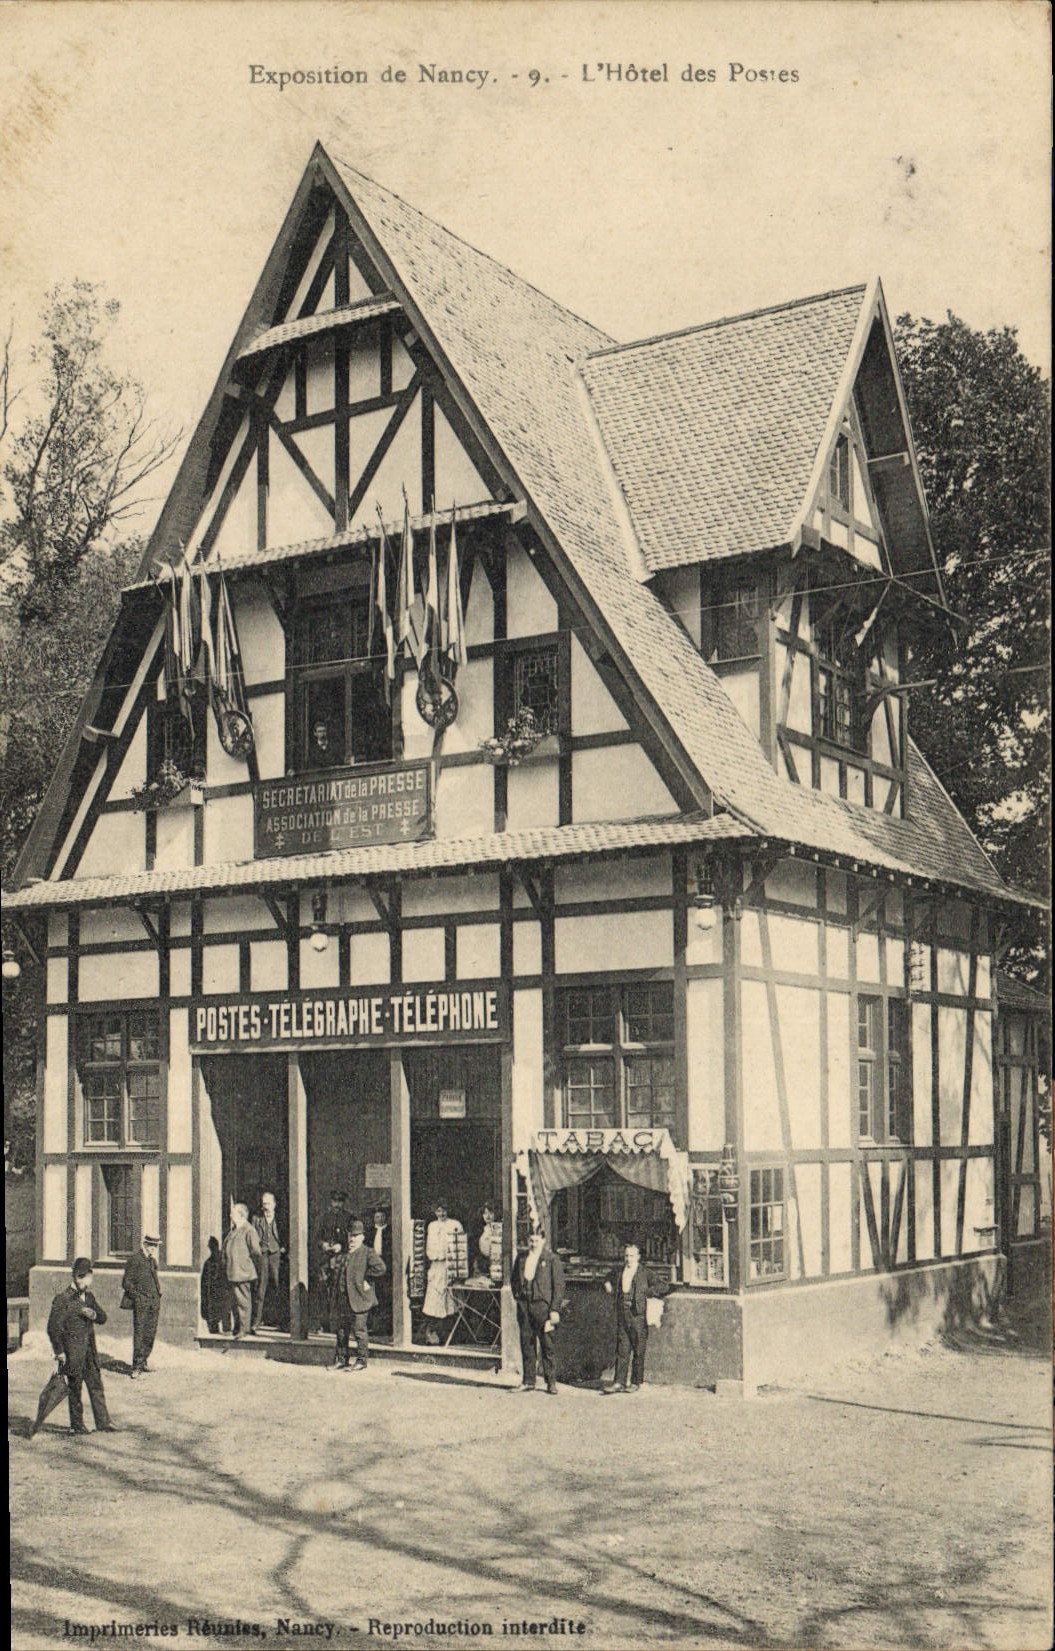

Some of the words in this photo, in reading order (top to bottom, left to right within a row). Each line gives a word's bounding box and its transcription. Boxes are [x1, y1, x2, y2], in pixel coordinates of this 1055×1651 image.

[345, 780, 356, 799] de
[358, 779, 368, 797] la
[369, 771, 424, 796] PRESSE
[266, 808, 341, 832] ASSOCIATION
[343, 807, 356, 824] de
[358, 806, 368, 822] la
[371, 799, 420, 820] PRESSE
[301, 830, 322, 844] DE
[196, 1004, 261, 1042] POSTES
[268, 997, 385, 1039] TÉLÉGRAPHE
[390, 989, 499, 1034] TÉLÉPHONE
[537, 1130, 654, 1147] TABAC
